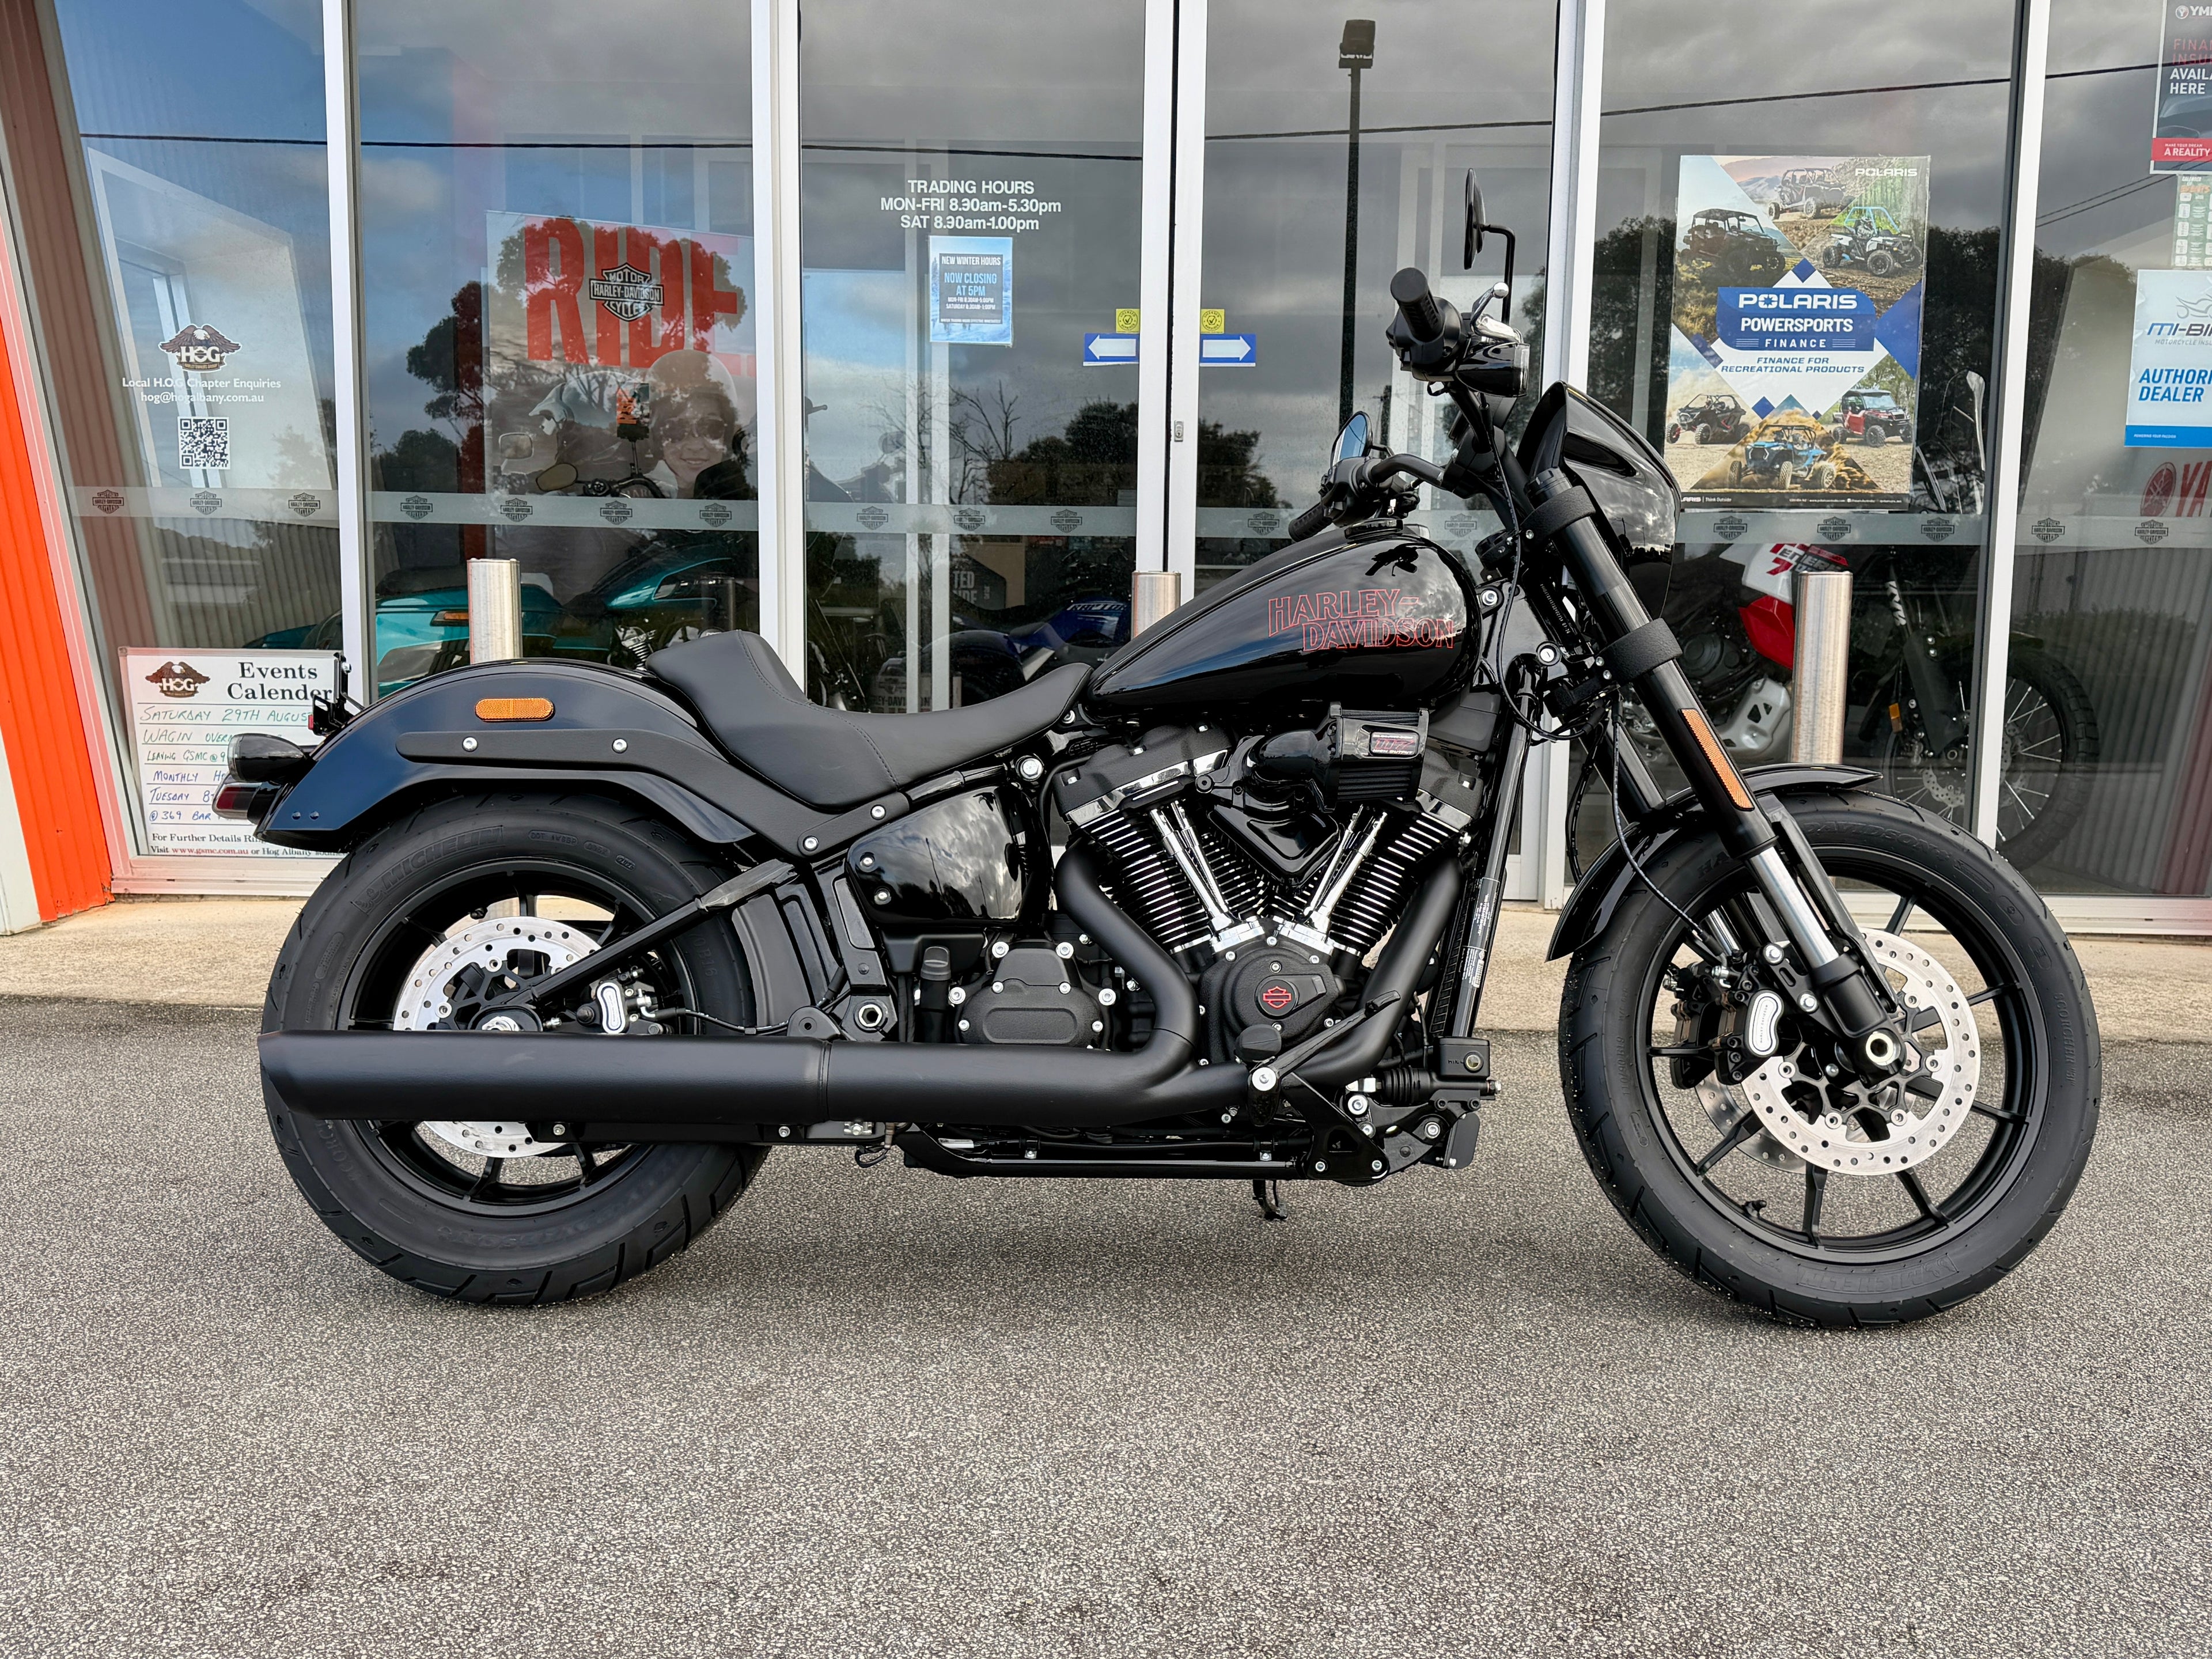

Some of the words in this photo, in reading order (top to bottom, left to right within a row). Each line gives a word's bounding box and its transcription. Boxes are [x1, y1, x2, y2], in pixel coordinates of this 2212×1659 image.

[2170, 82, 2206, 94] HERE
[2164, 147, 2171, 156] A
[2172, 148, 2211, 157] REALITY
[1854, 168, 1918, 177] POLARIS
[907, 180, 976, 194] TRADING
[982, 180, 1035, 194] HOURS
[880, 198, 945, 211] MON-FRI
[900, 215, 930, 229] SAT
[941, 256, 956, 264] NEW
[956, 256, 980, 265] WINTER
[980, 257, 1001, 266] HOURS
[609, 268, 644, 283] MOTOR
[944, 272, 963, 283] NOW
[964, 272, 997, 284] CLOSING
[593, 282, 660, 301] HARLEY-DAVIDSON
[956, 285, 967, 296] AT
[968, 286, 986, 296] 5PM
[1738, 294, 1858, 309] POLARIS
[609, 301, 646, 317] CYCLES
[1740, 317, 1854, 332] POWERSPORTS
[1765, 339, 1826, 347] FINANCE
[122, 377, 150, 388] Local
[187, 378, 230, 391] Chapter
[233, 378, 282, 391] Enquiries
[141, 392, 264, 404] hog@hogalbany.com.au
[2138, 387, 2205, 402] DEALER
[952, 571, 975, 589] TED
[1268, 589, 1419, 637] HARLEY-
[1302, 617, 1455, 652] DAVIDSON
[238, 662, 317, 679] Events
[140, 706, 211, 721] SATURDAY
[222, 709, 260, 722] 29TH
[153, 770, 198, 782] MONTHLY
[150, 786, 190, 802] TUESDAY
[192, 810, 211, 821] BAR
[152, 833, 167, 841] For
[170, 834, 206, 842] Further
[209, 834, 241, 842] Details
[262, 848, 279, 857] Hog
[282, 847, 312, 857] Albany
[383, 827, 503, 888] MICHELIN
